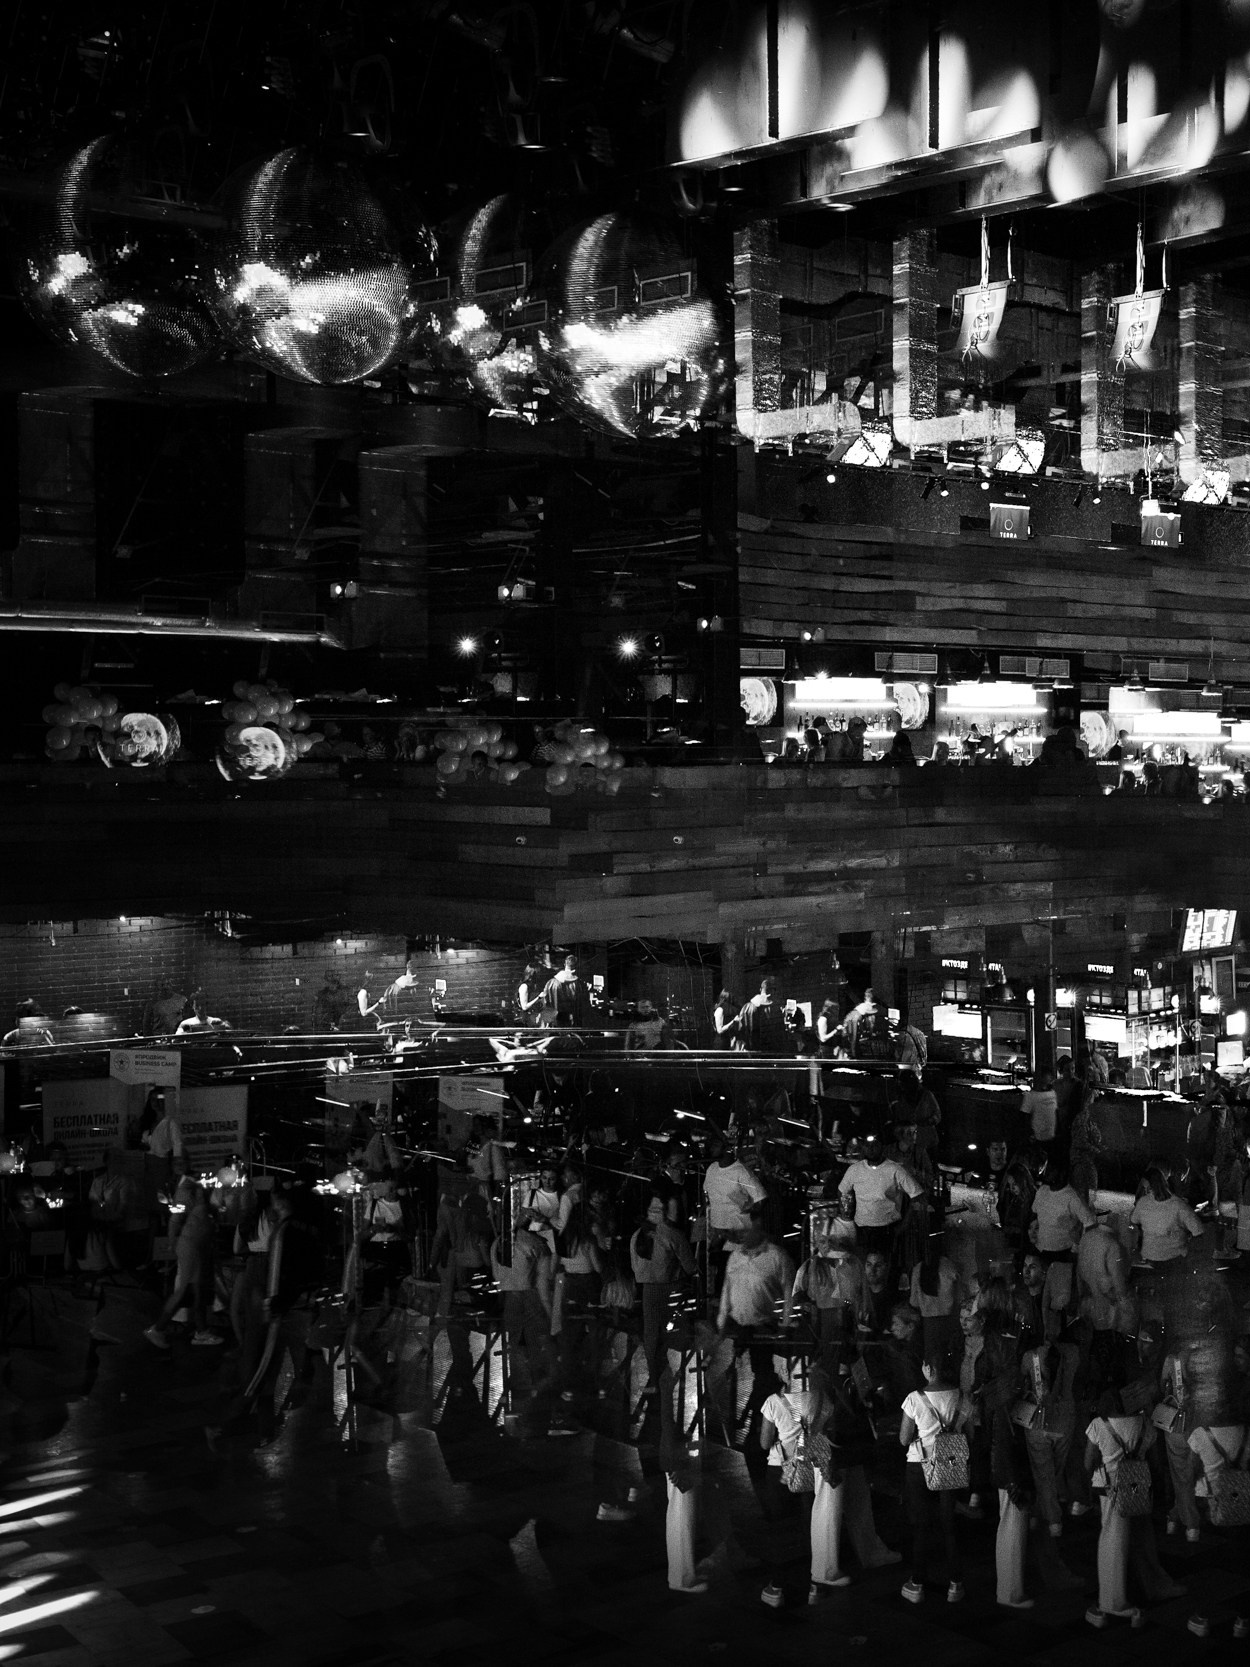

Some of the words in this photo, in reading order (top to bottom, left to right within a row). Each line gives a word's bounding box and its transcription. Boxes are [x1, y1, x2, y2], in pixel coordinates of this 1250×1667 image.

[999, 531, 1018, 539] TERRA
[53, 1112, 119, 1129] БЕСПЛАТНАЯ
[182, 1120, 238, 1134] ЕСПЛАТНАЯ
[53, 1126, 119, 1141] ОНЛАЙН-ШКОЛА
